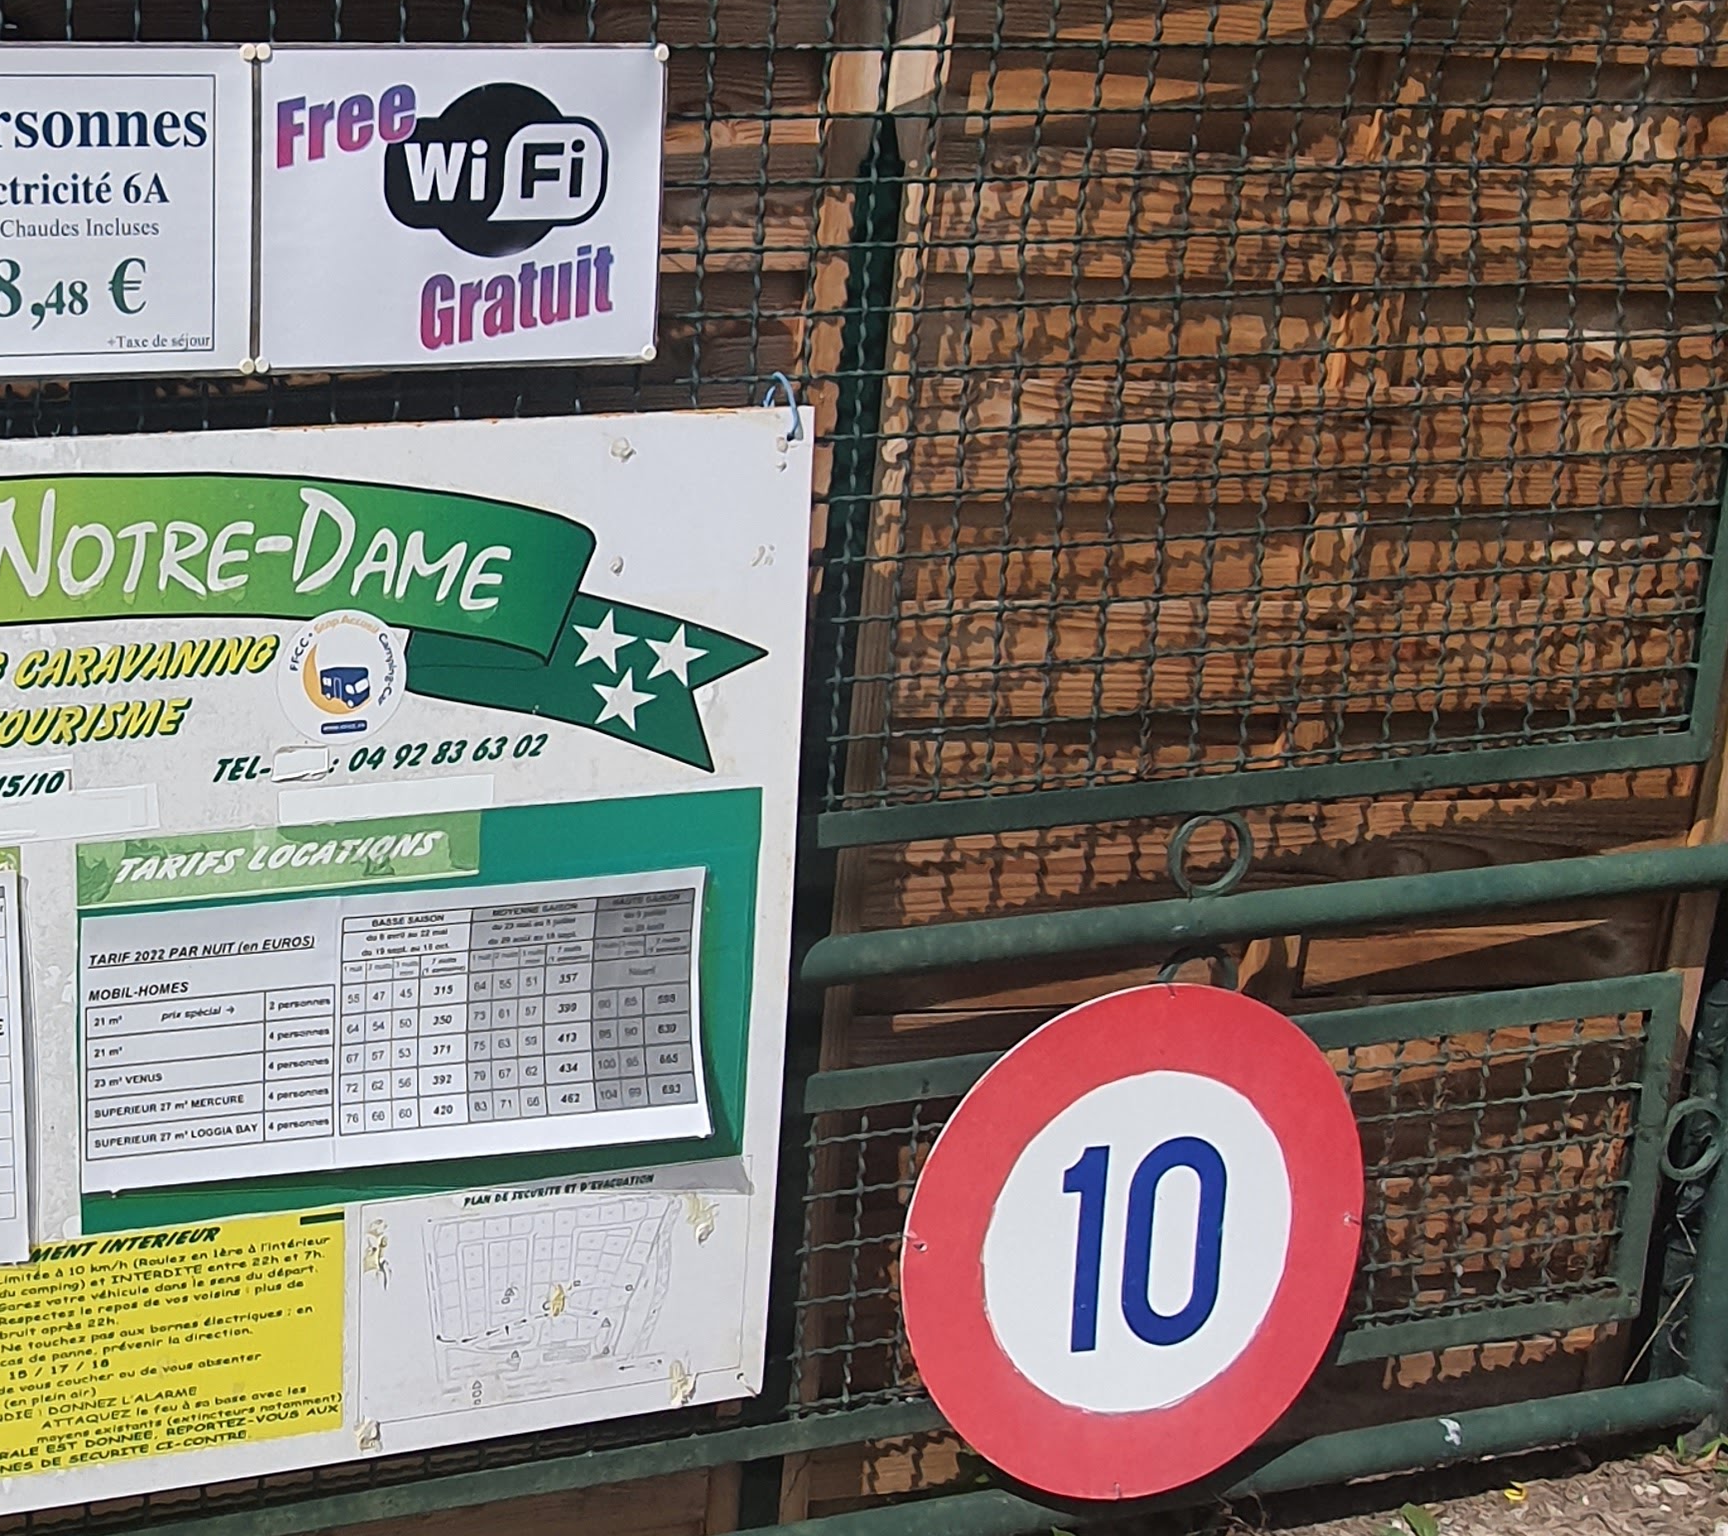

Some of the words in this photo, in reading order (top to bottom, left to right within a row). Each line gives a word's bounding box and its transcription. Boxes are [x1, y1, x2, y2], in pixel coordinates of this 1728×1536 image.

[276, 83, 416, 169] Free
[123, 173, 170, 204] 6A
[0, 219, 79, 237] Chaudes
[86, 219, 159, 236] Incluses
[108, 258, 147, 315] €
[420, 243, 613, 350] Gratuit
[108, 335, 149, 348] +Taxe
[152, 334, 167, 347] de
[172, 334, 210, 350] séjour
[13, 633, 280, 690] CARAVANING
[348, 746, 386, 773] 04
[392, 744, 427, 769] 92
[431, 740, 466, 765] 83
[472, 738, 506, 763] 63
[514, 733, 548, 759] 02
[115, 847, 245, 885] TARIFS
[247, 830, 445, 872] LOCATIONS
[89, 951, 131, 967] TARIF
[134, 948, 165, 961] 2022
[168, 945, 198, 958] PAR
[202, 942, 235, 956] NUIT
[238, 940, 259, 954] (en
[262, 935, 315, 951] EUROS)
[89, 982, 189, 1001] MOBIL-HOMES
[464, 1193, 490, 1207] PLAN
[494, 1192, 508, 1202] DE
[99, 1227, 221, 1254] INTERIEUR
[1062, 1135, 1227, 1353] 10
